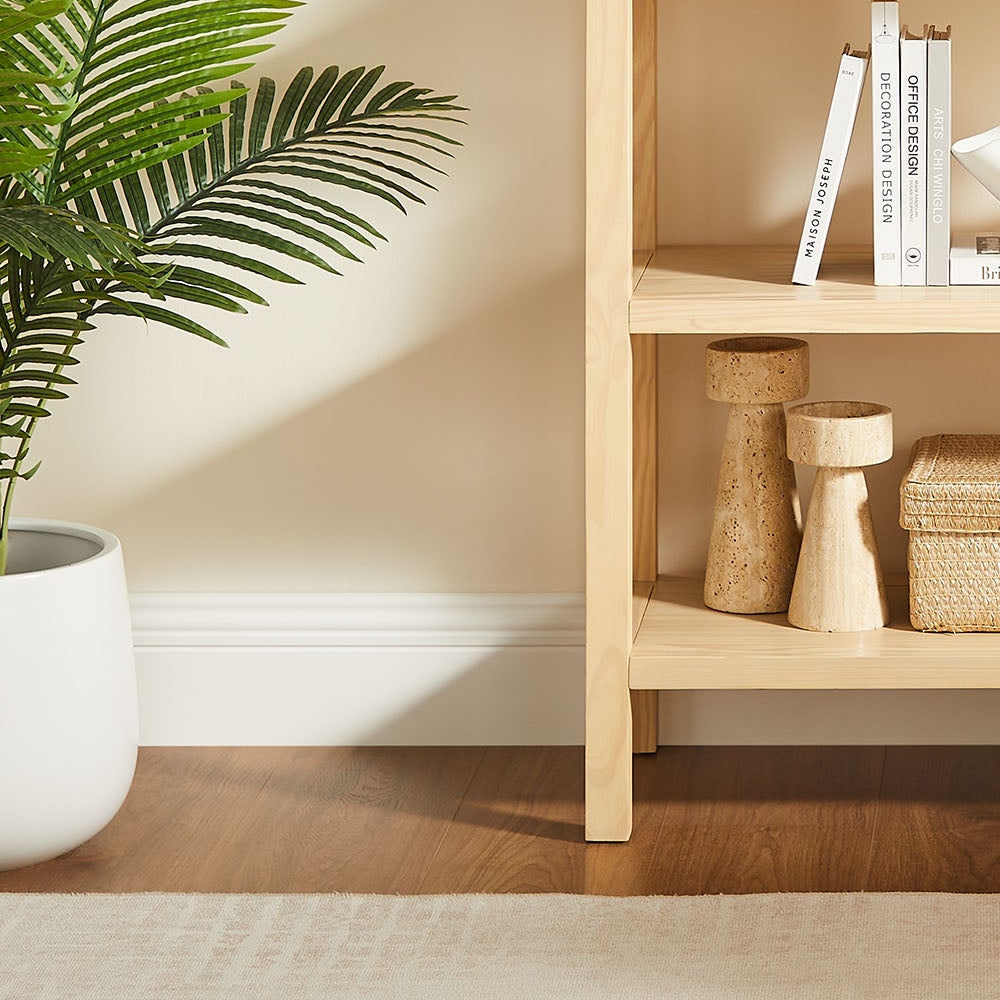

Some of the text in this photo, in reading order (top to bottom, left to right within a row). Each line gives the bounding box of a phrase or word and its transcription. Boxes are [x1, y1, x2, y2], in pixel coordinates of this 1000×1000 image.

[880, 72, 893, 224] DECORATION DESIGN
[907, 74, 919, 176] OFFICE DESIGN
[932, 107, 944, 224] ARTS CHI WINGLO
[804, 157, 834, 259] MAISON JOSEPH
